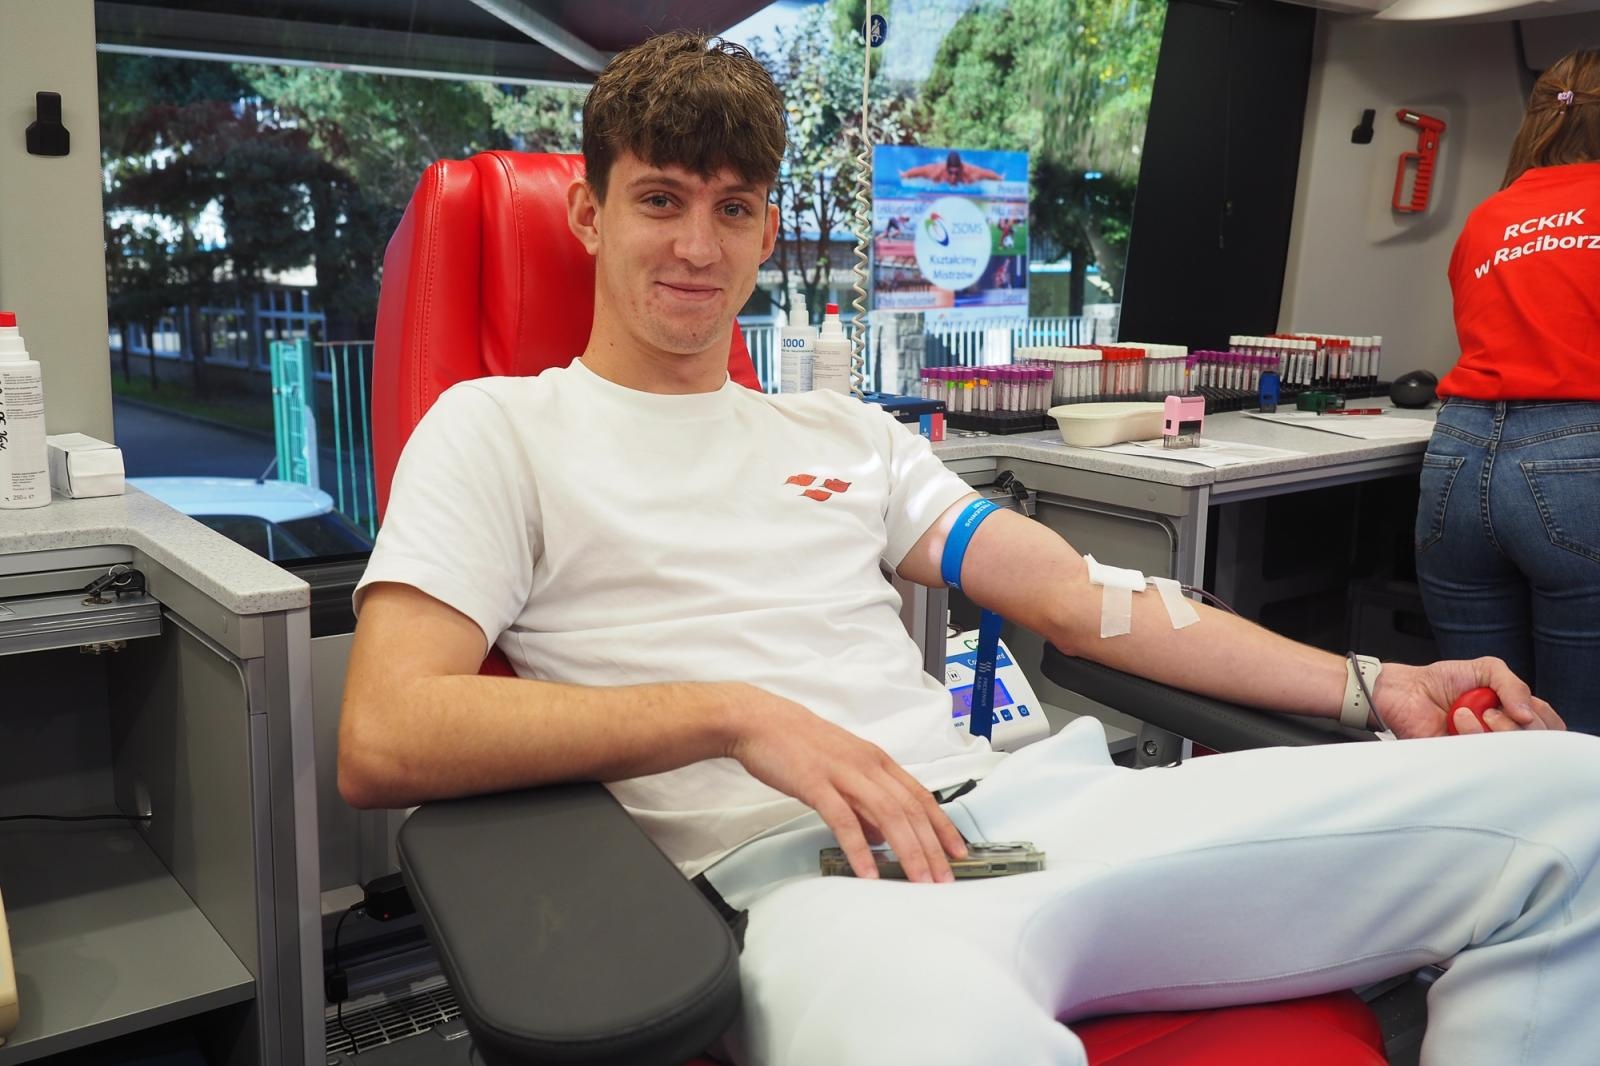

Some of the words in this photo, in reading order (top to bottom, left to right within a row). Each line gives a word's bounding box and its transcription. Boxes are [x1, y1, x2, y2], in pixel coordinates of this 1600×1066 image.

[1503, 208, 1586, 241] RCKiK
[1474, 259, 1491, 279] w
[783, 338, 805, 348] 1000
